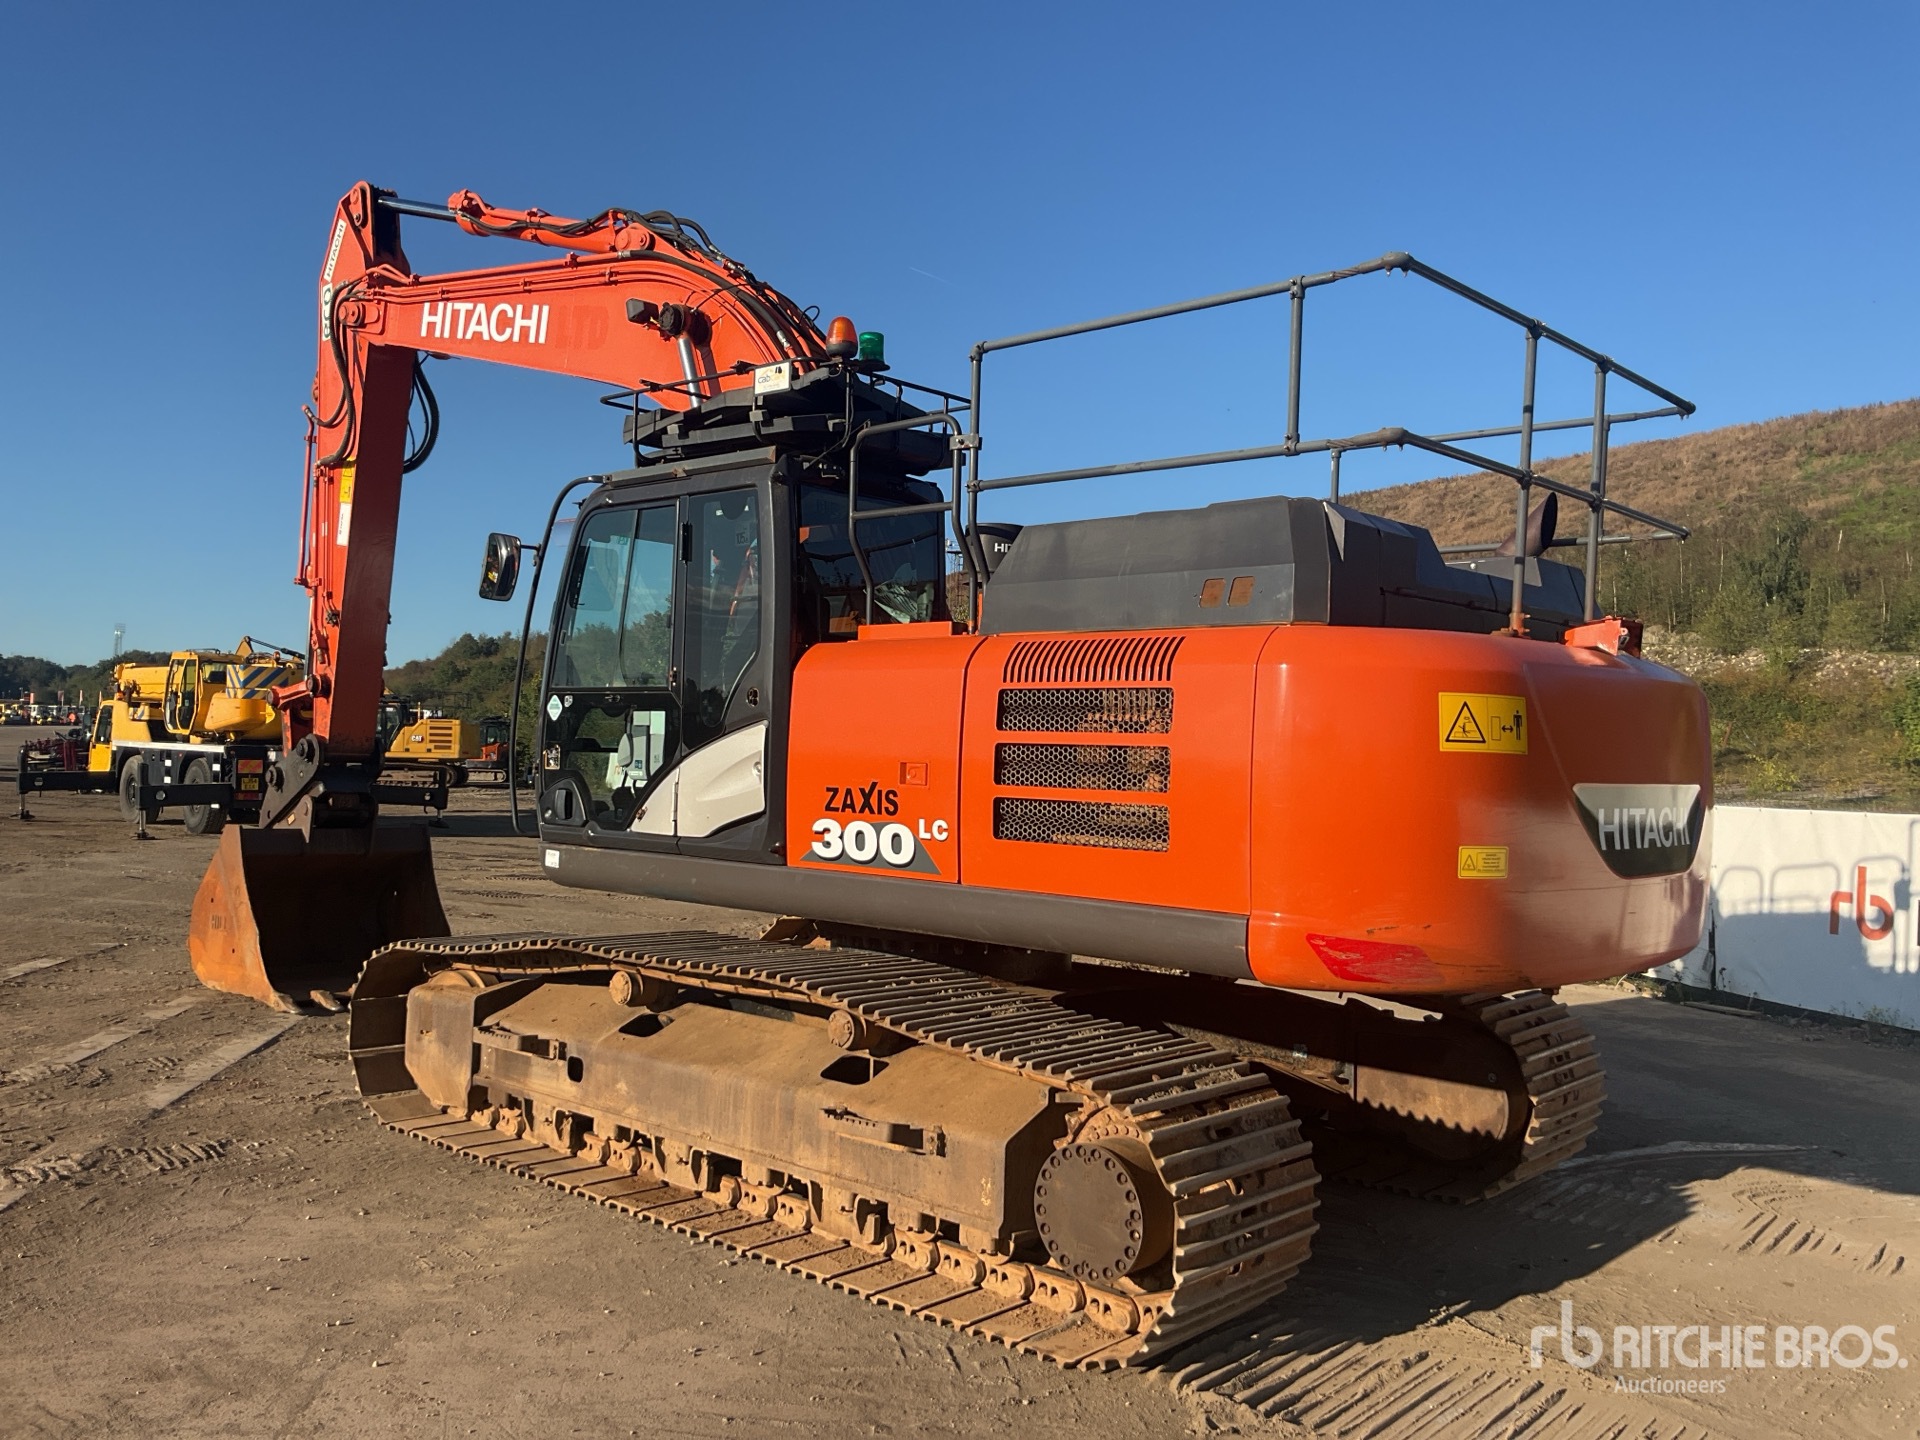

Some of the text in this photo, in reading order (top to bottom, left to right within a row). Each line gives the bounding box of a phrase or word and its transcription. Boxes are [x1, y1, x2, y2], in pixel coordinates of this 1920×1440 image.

[326, 223, 344, 278] HITACHI
[420, 301, 549, 344] HITACHI
[824, 781, 899, 816] ZAXIS
[811, 818, 949, 866] 300 LC
[1597, 806, 1690, 851] HITACHI
[1829, 866, 1894, 941] rb
